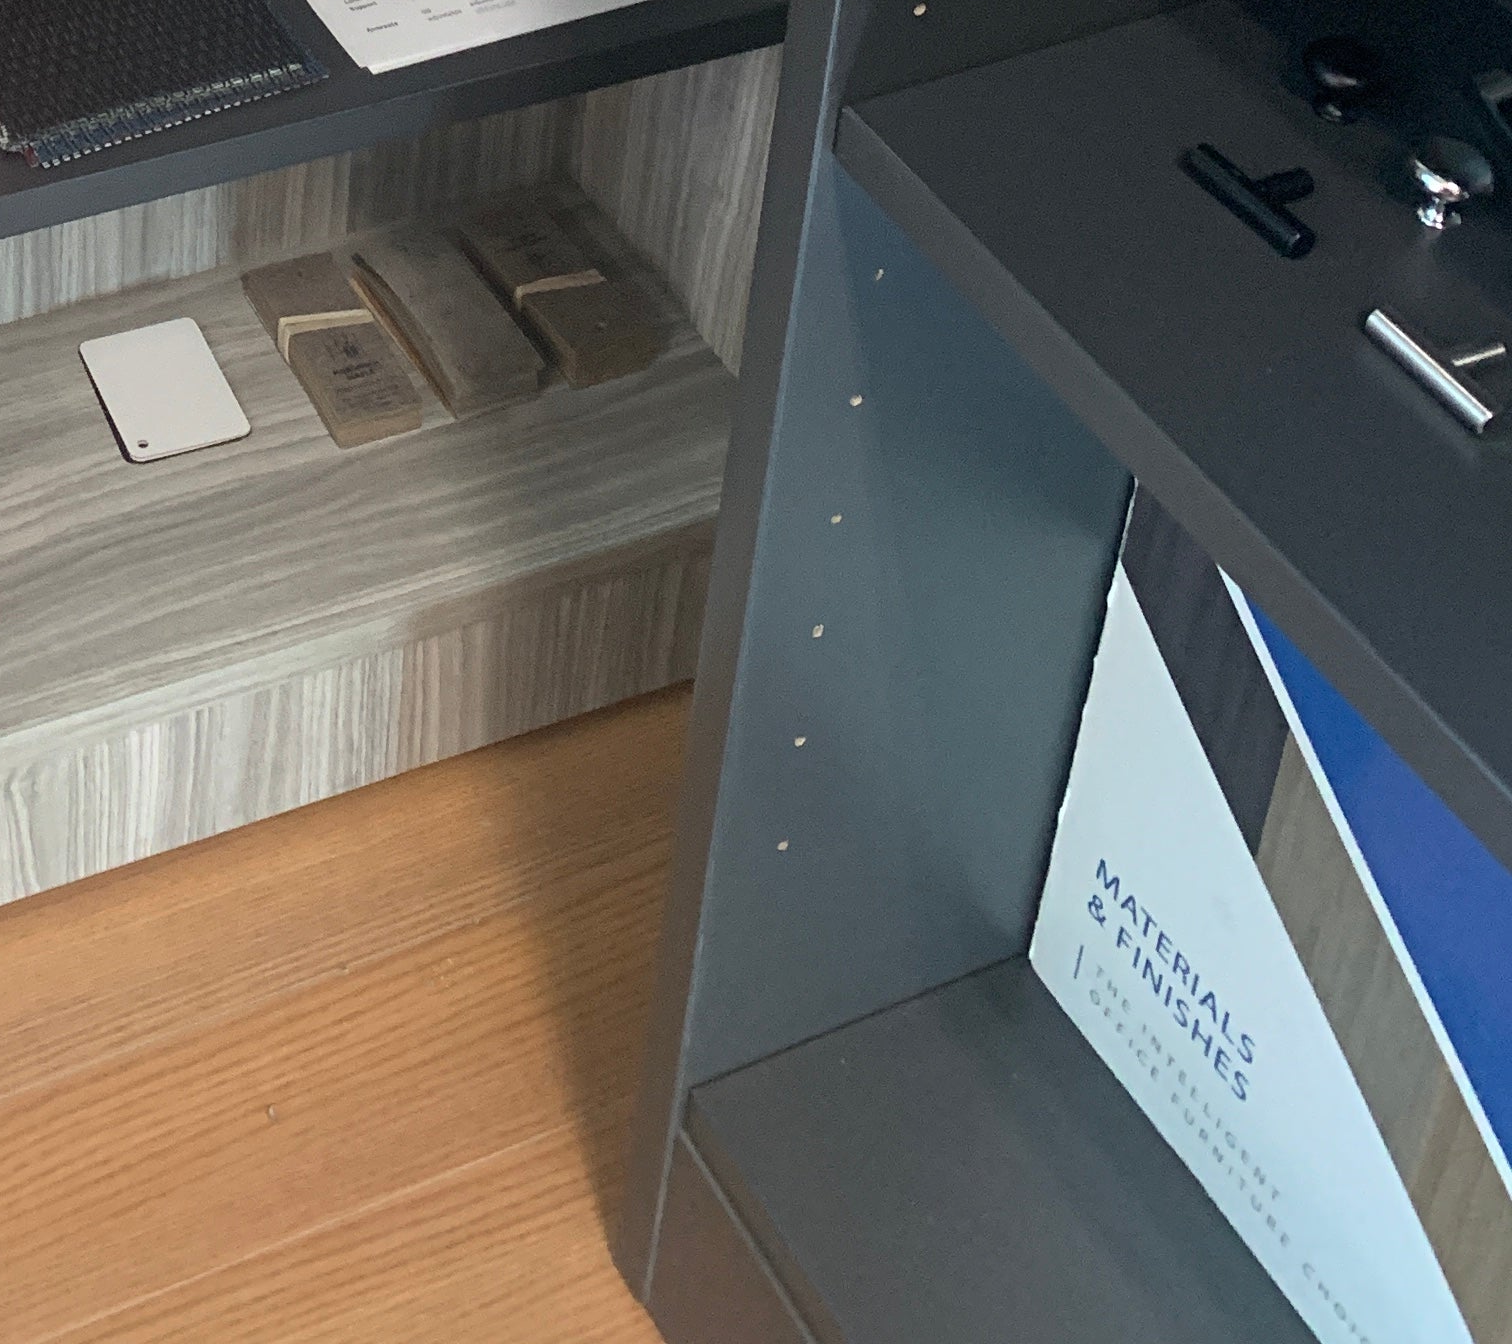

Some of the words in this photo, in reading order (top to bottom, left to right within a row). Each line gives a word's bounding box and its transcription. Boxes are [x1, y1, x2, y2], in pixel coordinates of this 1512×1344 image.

[1088, 893, 1106, 927] &
[1116, 923, 1249, 1102] FINISHES
[1096, 858, 1256, 1064] MATERIALS
[1089, 988, 1159, 1082] OFFICE
[1171, 1091, 1290, 1248] FURNITURE
[1095, 965, 1131, 1013] THE
[1141, 1023, 1281, 1201] INTELLIGENT
